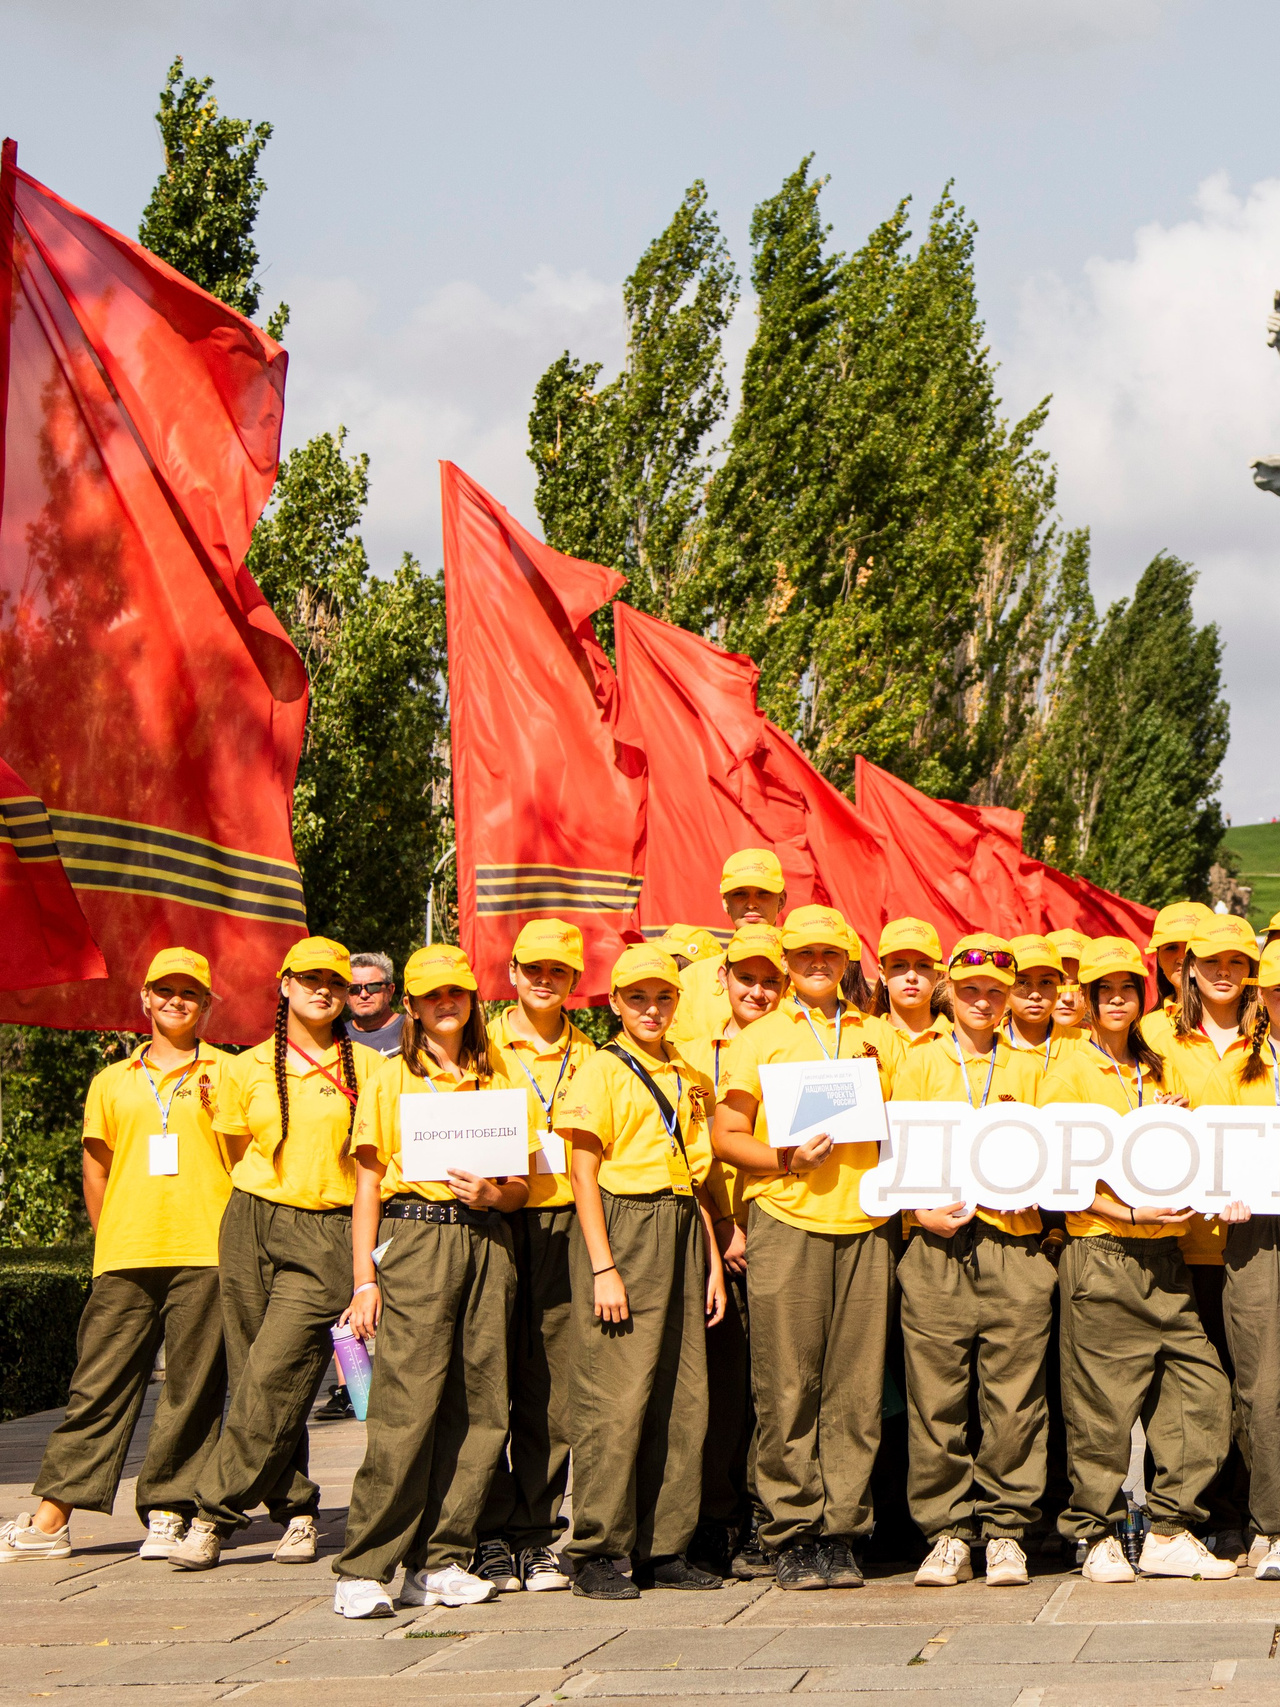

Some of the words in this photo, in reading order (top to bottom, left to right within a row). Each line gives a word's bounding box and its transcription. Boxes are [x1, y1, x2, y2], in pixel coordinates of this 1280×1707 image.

[804, 1083, 854, 1093] НАЦИОНАЛЬНЫЕ
[826, 1091, 855, 1099] ПРОЕКТЫ
[832, 1098, 857, 1106] РОССИИ
[413, 1129, 463, 1142] ДОРОГИ
[466, 1126, 517, 1139] ПОБЕДЫ
